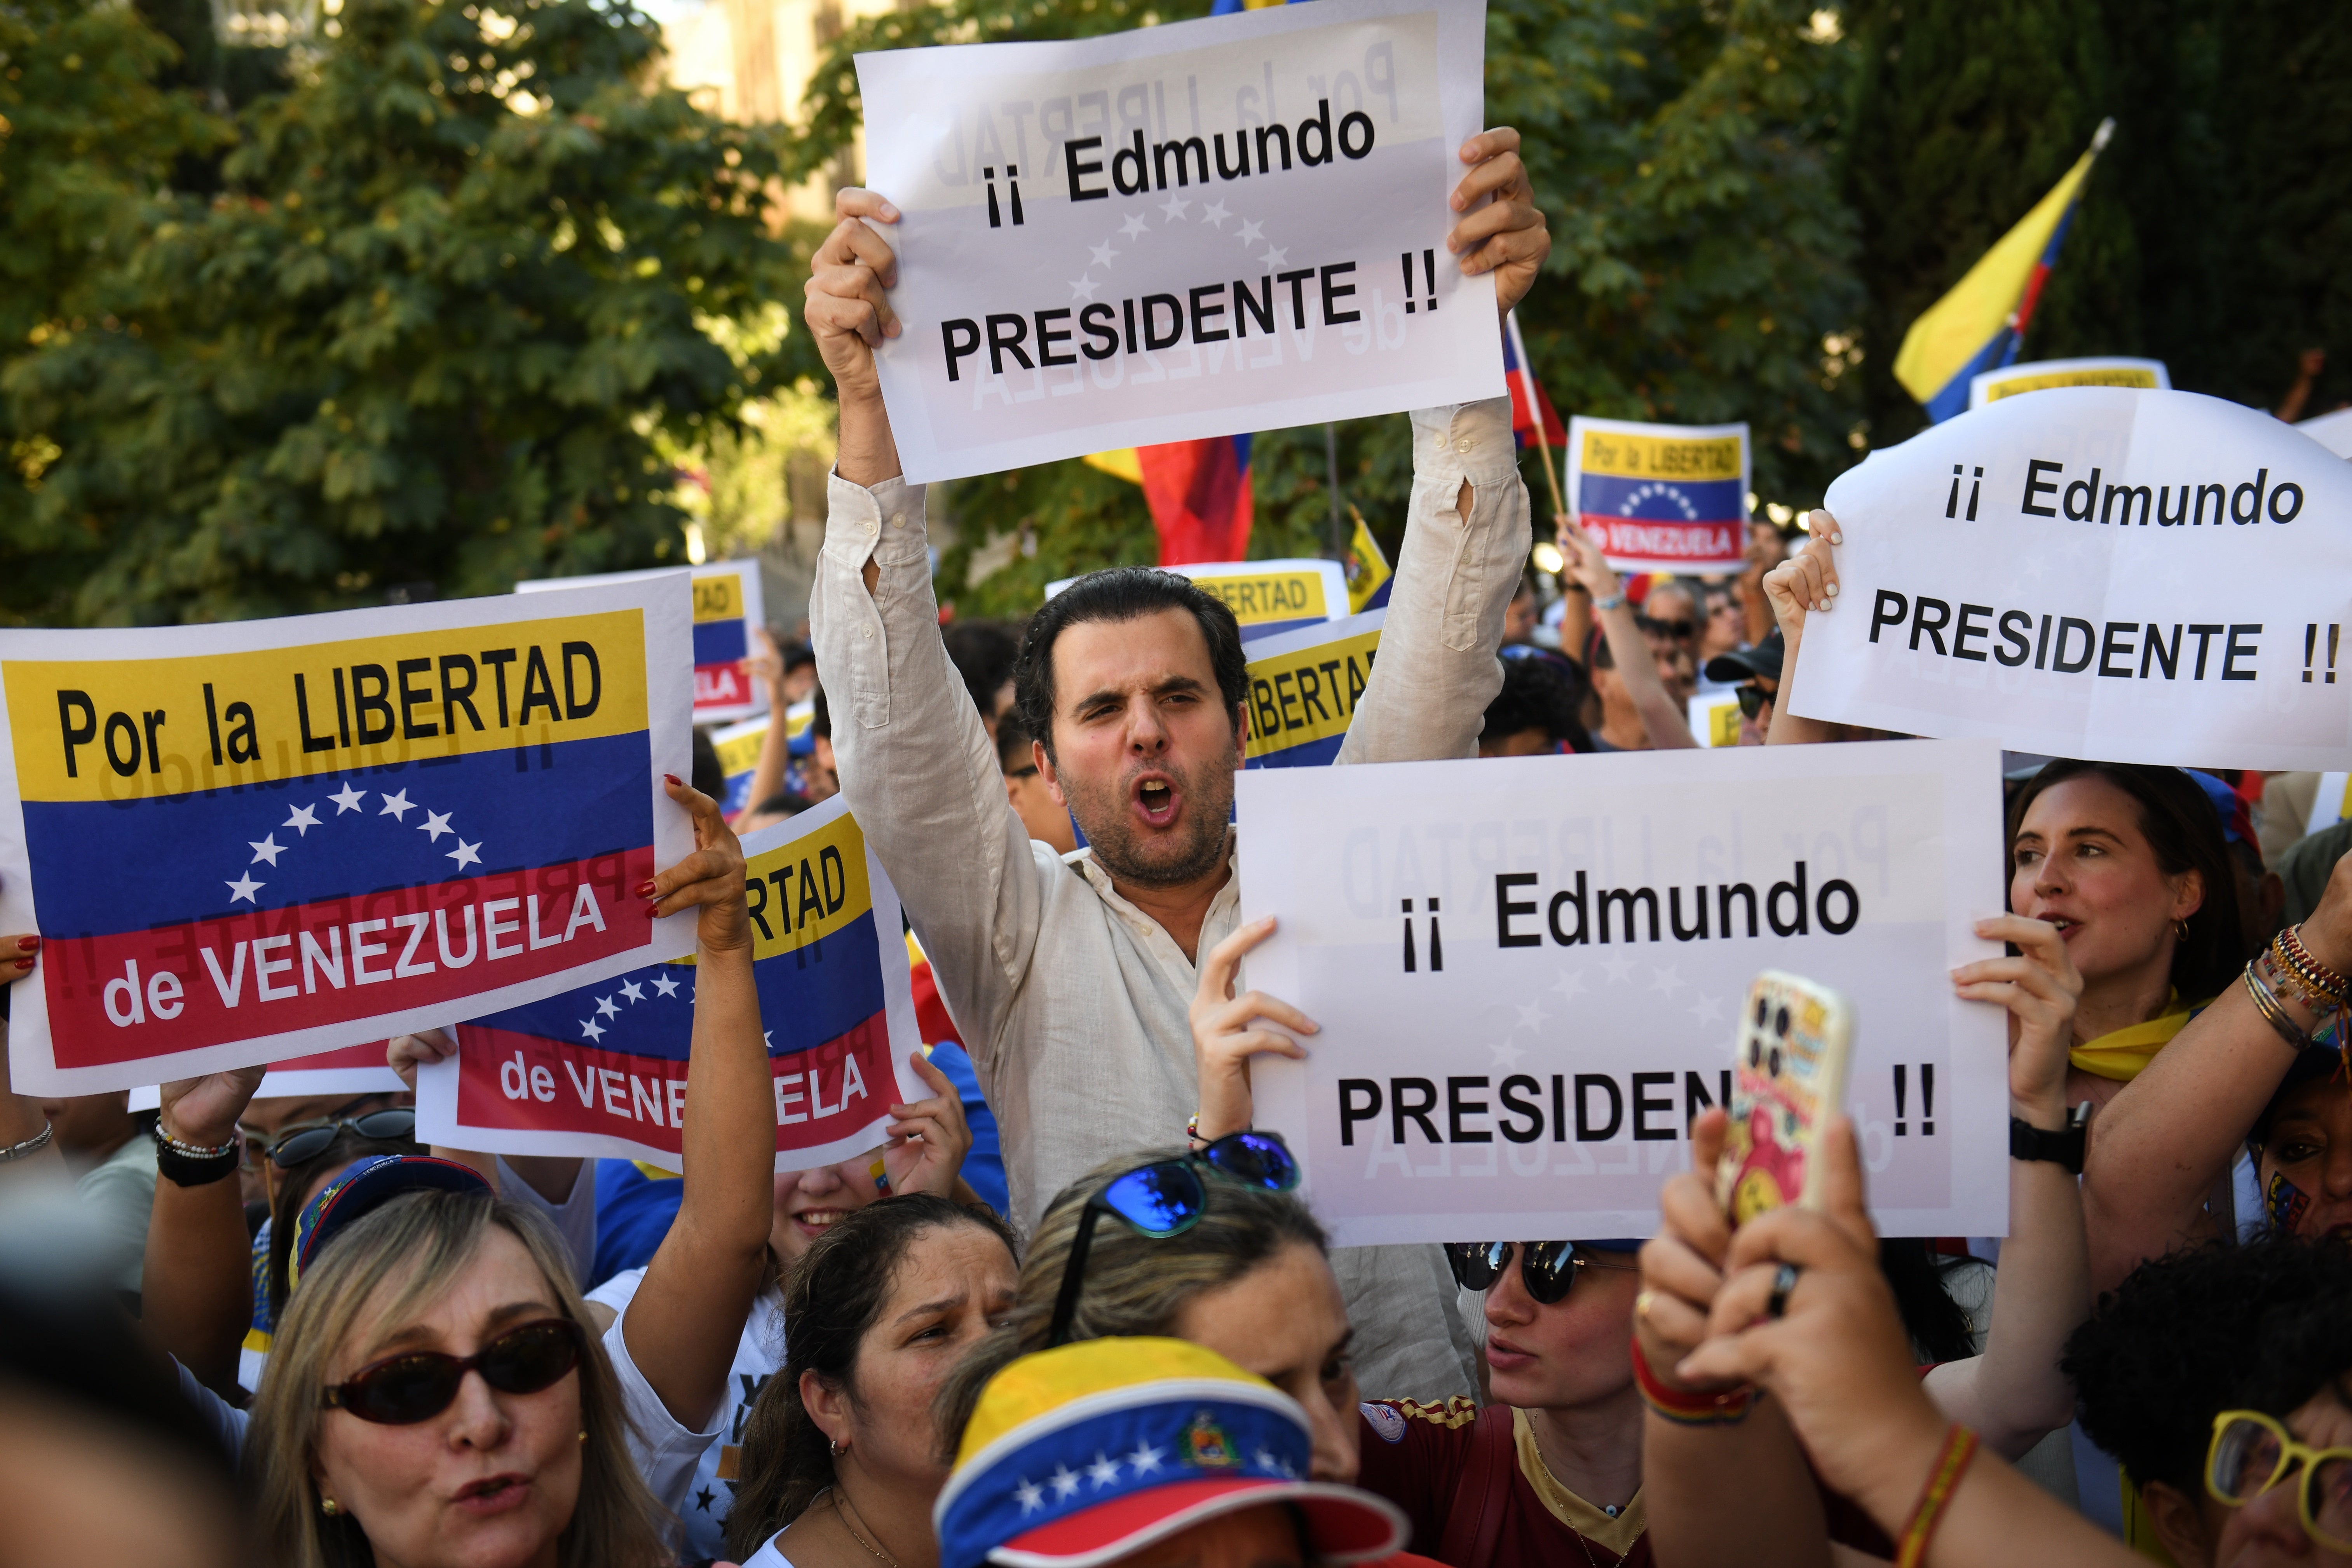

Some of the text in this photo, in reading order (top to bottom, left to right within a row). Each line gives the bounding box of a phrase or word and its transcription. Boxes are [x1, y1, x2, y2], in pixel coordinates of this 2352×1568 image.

[983, 98, 1375, 228] ¡¡ Edmundo
[941, 249, 1438, 382] PRESIDENTE !!
[1609, 523, 1733, 556] VENEZUELA
[1945, 459, 2303, 527] ¡¡ Edmundo
[1221, 578, 1307, 616] ERTAD
[1869, 589, 2339, 684] PRESIDENTE !!
[57, 641, 601, 777] Por la LIBERTAD
[1247, 650, 1377, 741] IBERTA
[745, 845, 846, 941] RTAD
[1402, 861, 1859, 973] ¡¡ Edmundo
[104, 883, 607, 1027] de VENEZUELA
[500, 1050, 868, 1129] de VENEELA
[1338, 1070, 1731, 1146] PRESIDEN
[1893, 1063, 1935, 1136] !!
[362, 1159, 394, 1176] VENEZUELA
